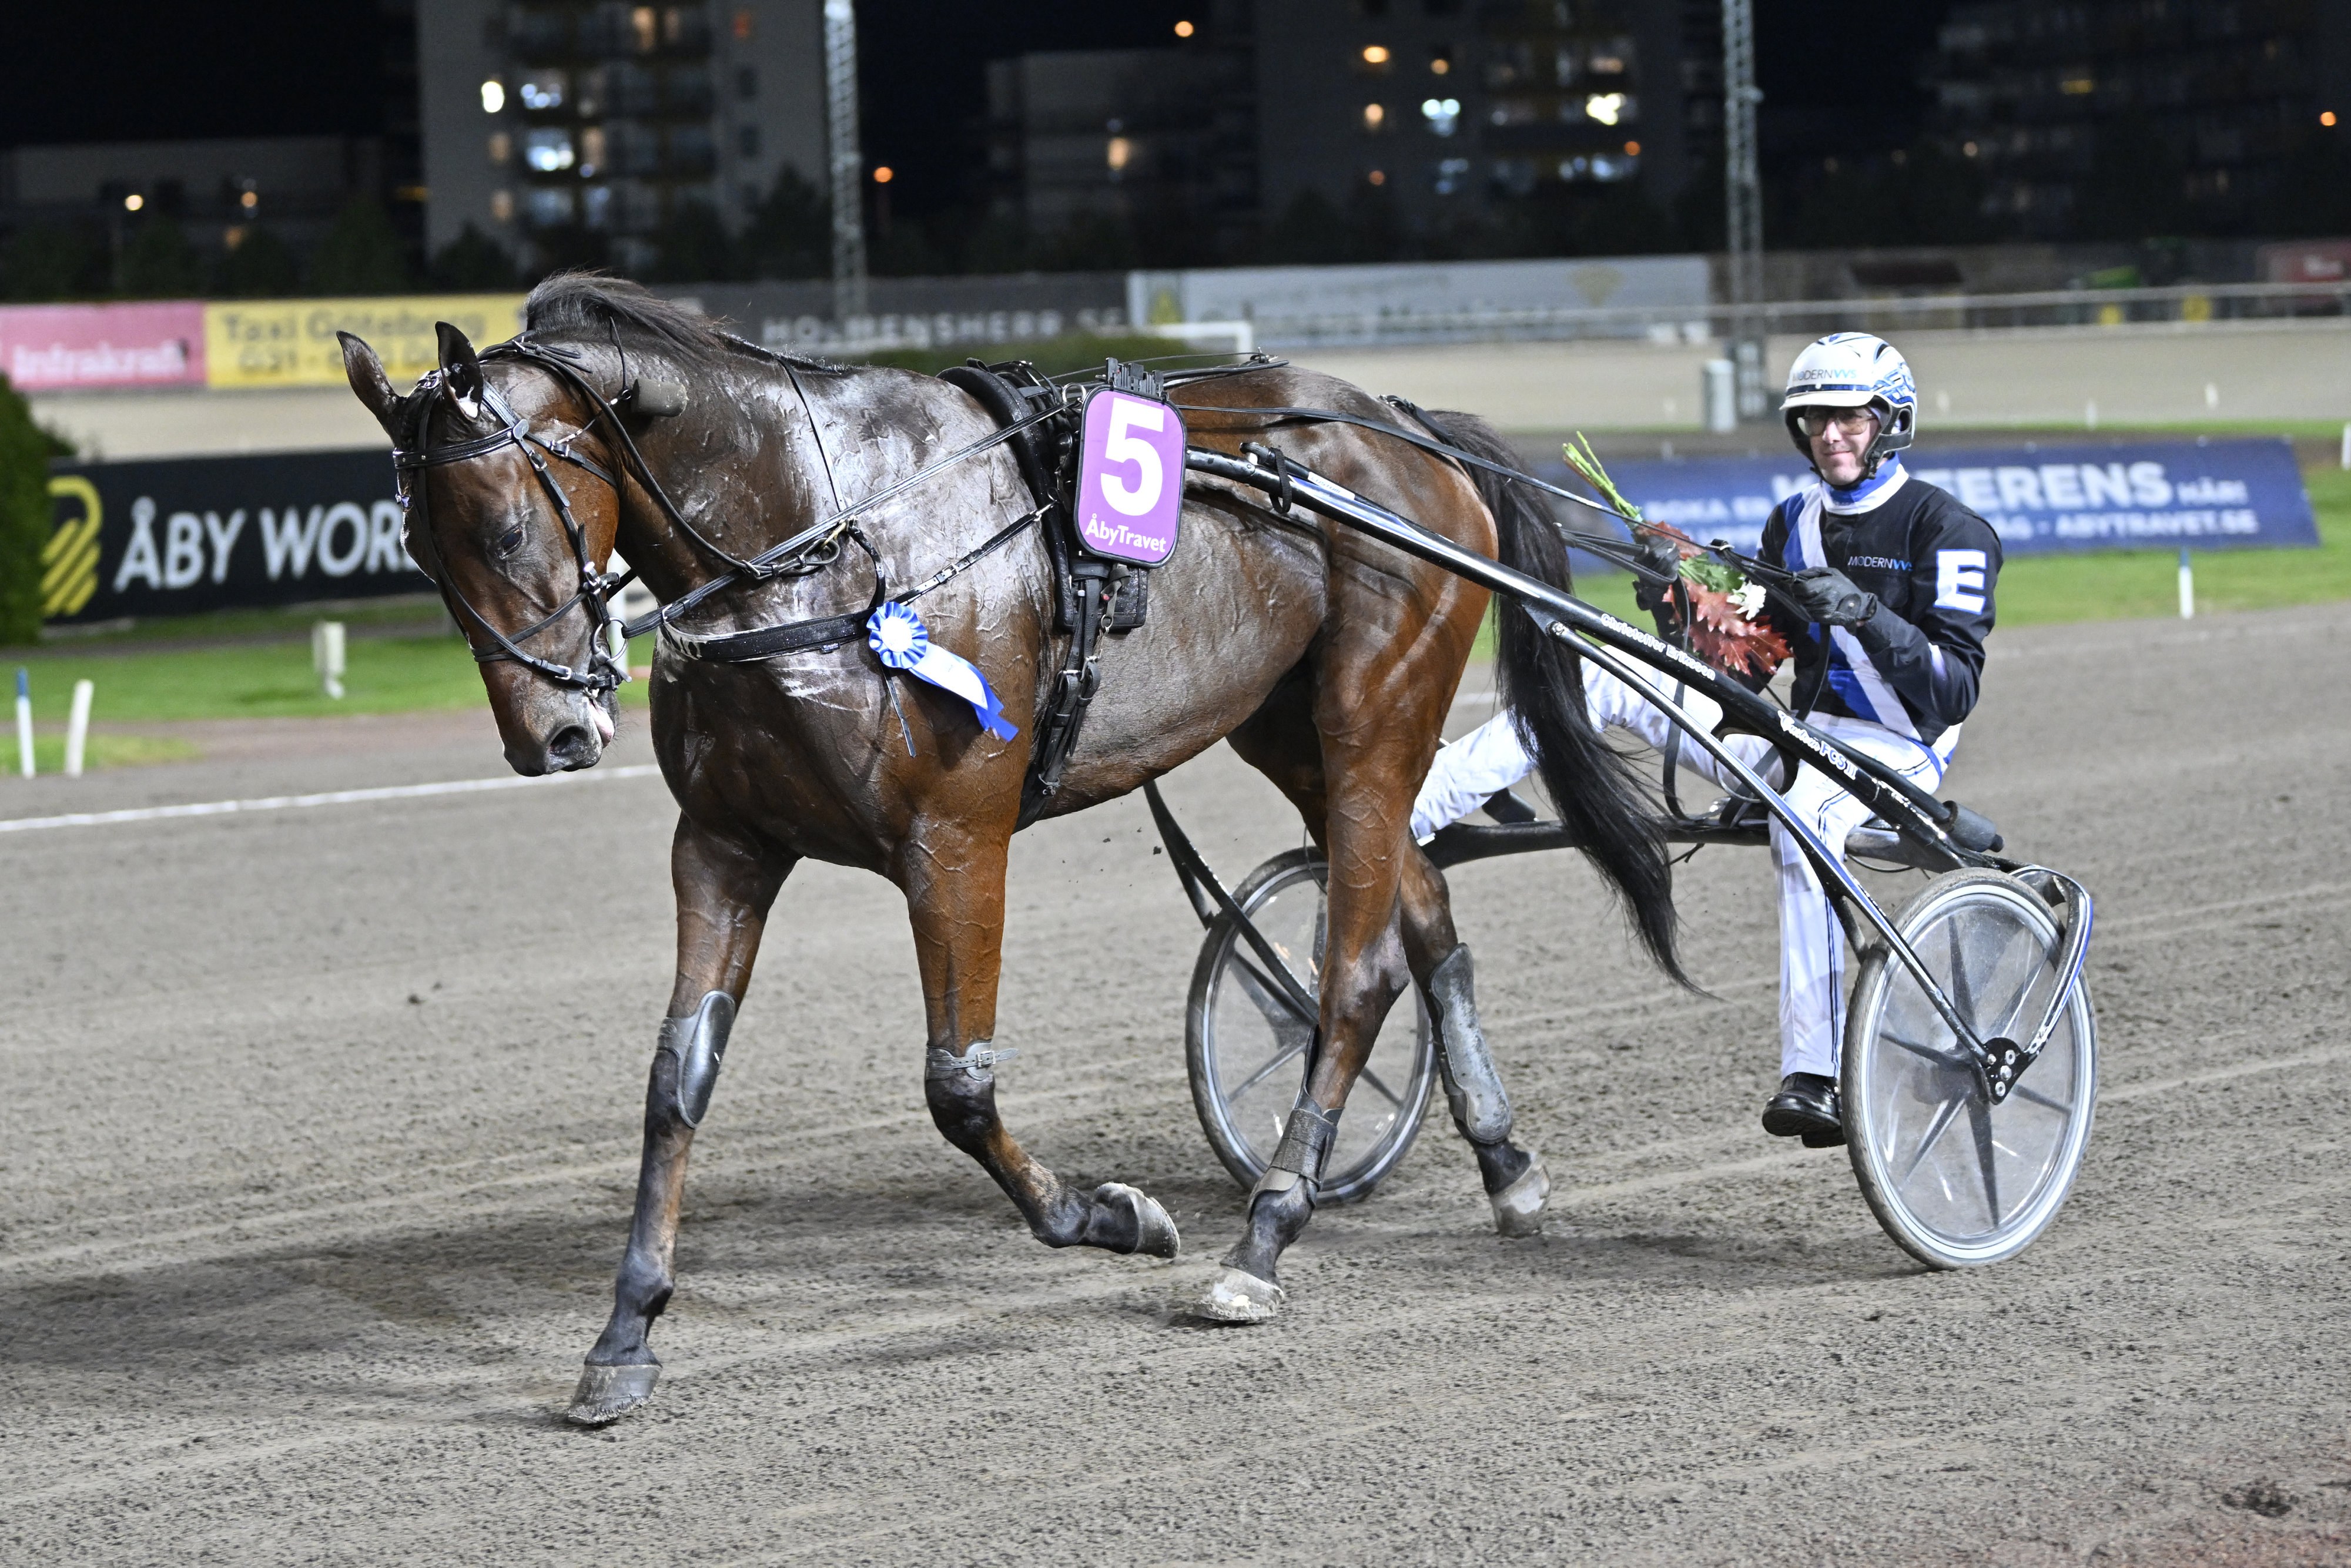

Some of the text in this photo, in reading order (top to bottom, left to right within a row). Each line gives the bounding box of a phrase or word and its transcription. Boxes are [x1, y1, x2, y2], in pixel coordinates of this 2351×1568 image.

[1100, 397, 1164, 516] 5
[114, 497, 248, 592] ÅBY
[1085, 513, 1167, 552] ÅbyTravet
[1934, 549, 1987, 615] E
